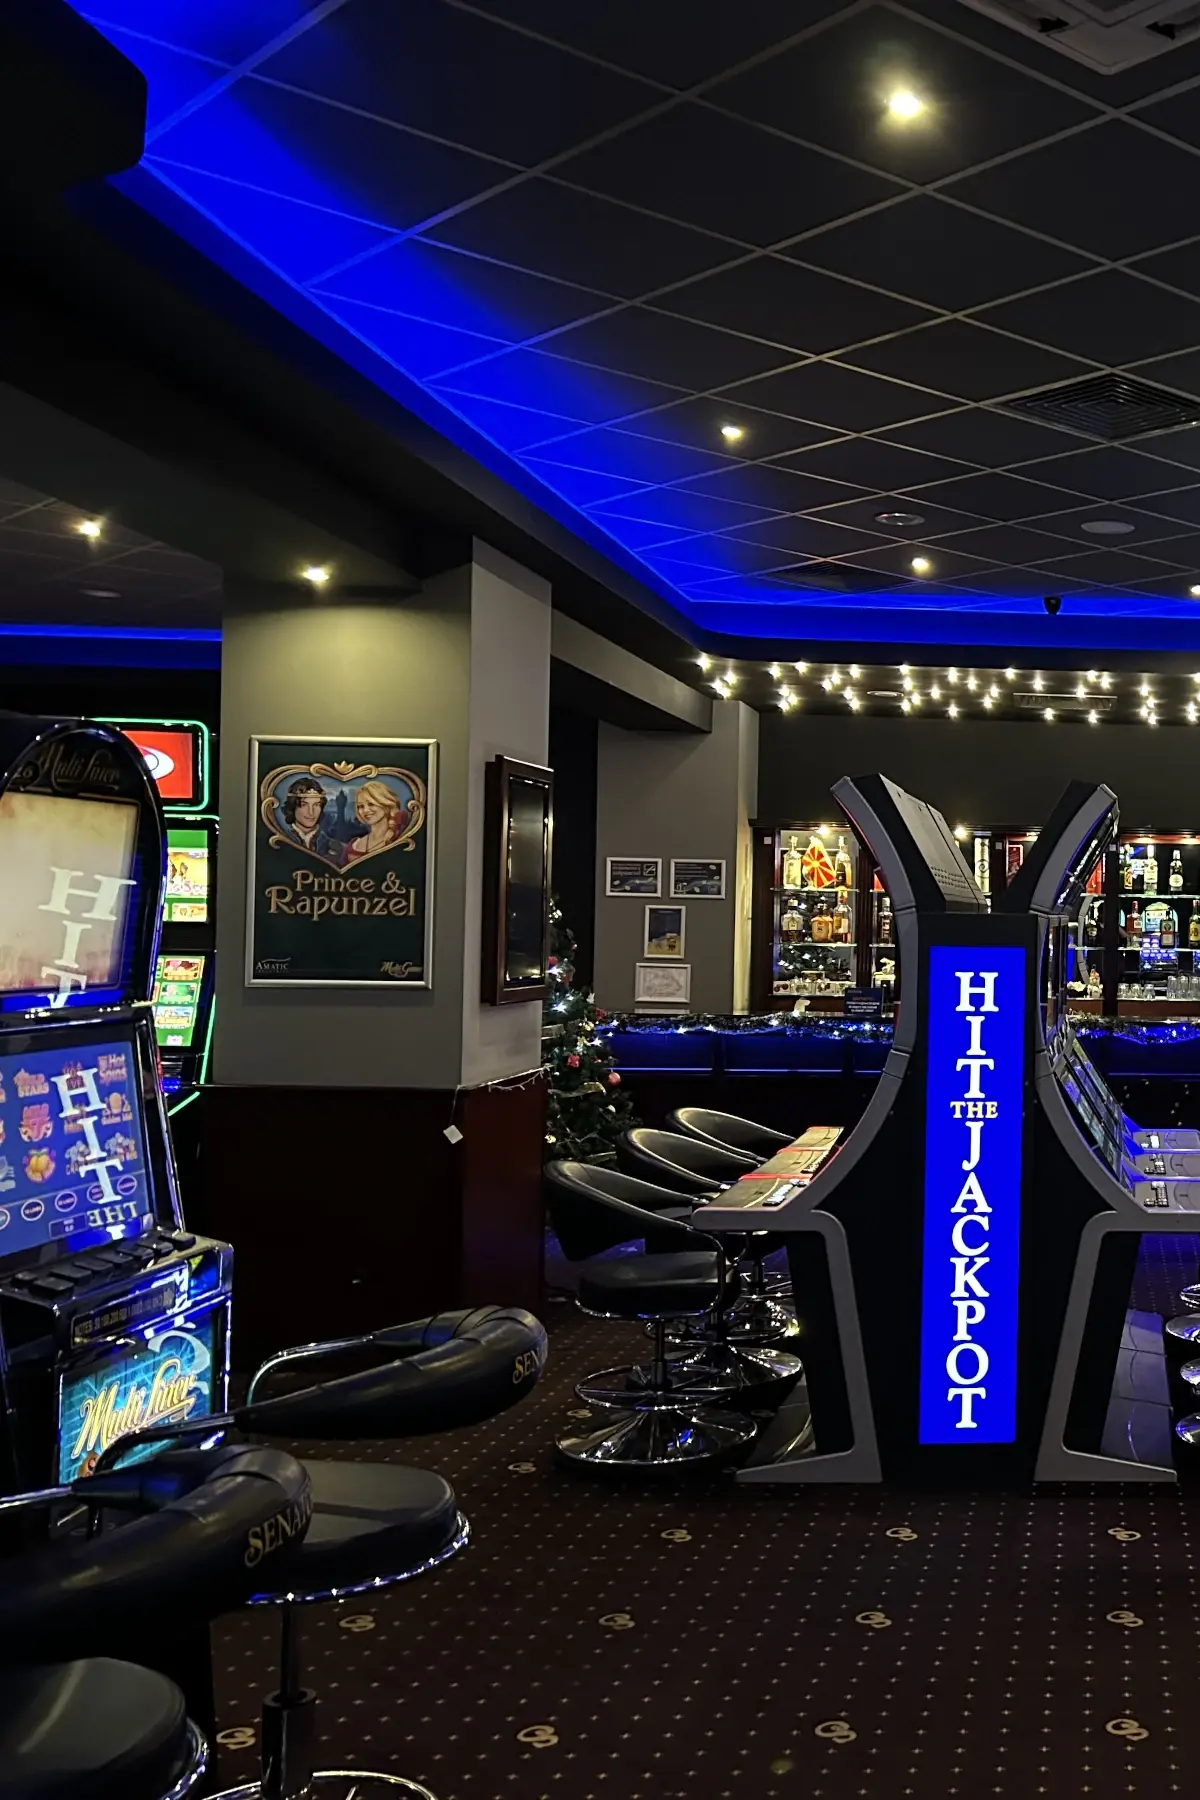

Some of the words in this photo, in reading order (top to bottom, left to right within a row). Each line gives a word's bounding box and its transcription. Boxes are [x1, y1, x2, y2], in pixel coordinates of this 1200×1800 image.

[264, 885, 417, 922] Rapunzel
[292, 869, 376, 893] Prince
[381, 870, 407, 895] &
[954, 970, 1000, 1099] HIT
[949, 1100, 999, 1120] THE
[945, 1120, 993, 1429] JACKPOT
[70, 1380, 147, 1460] Multi
[142, 1356, 198, 1424] Liner
